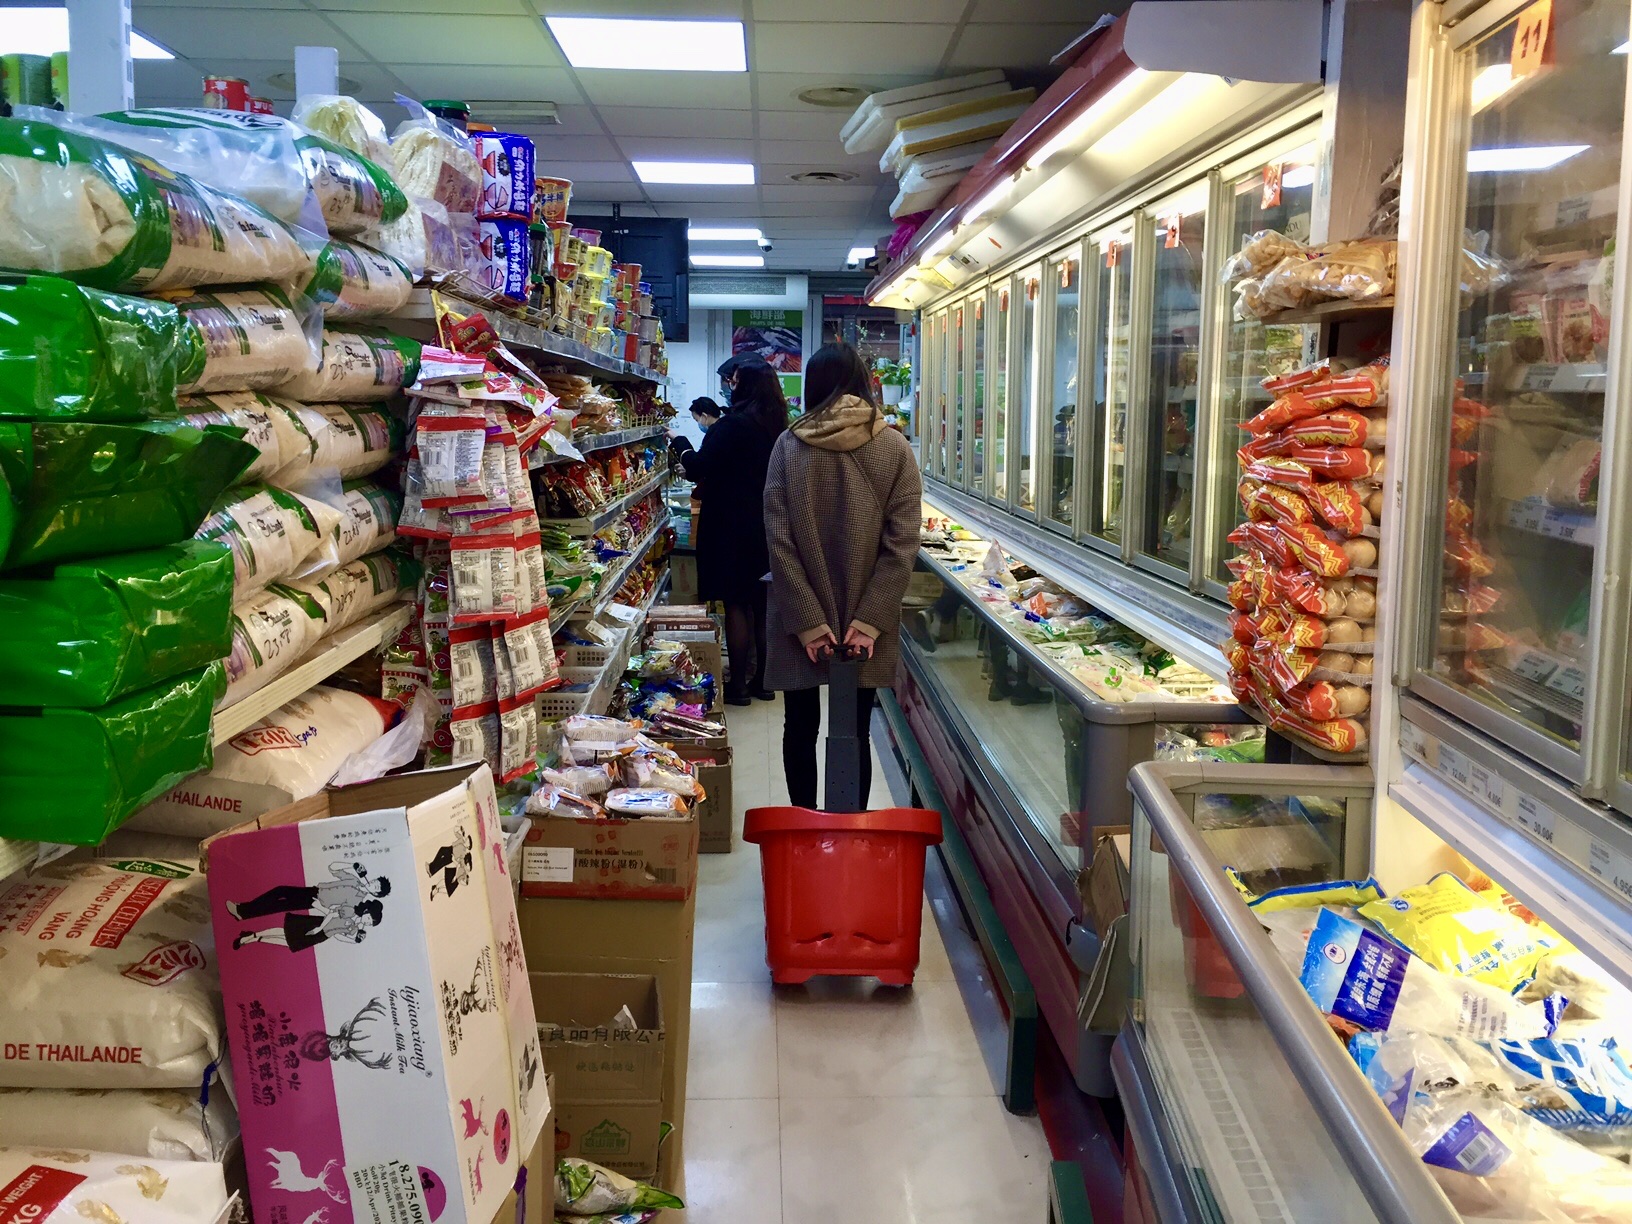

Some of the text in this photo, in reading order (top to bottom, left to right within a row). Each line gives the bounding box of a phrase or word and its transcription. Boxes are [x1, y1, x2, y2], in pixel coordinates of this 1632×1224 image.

[387, 988, 408, 1074] Instant Milk Tea
[4, 1044, 142, 1064] DE THAILANDE
[1, 1173, 43, 1203] WEIGHT
